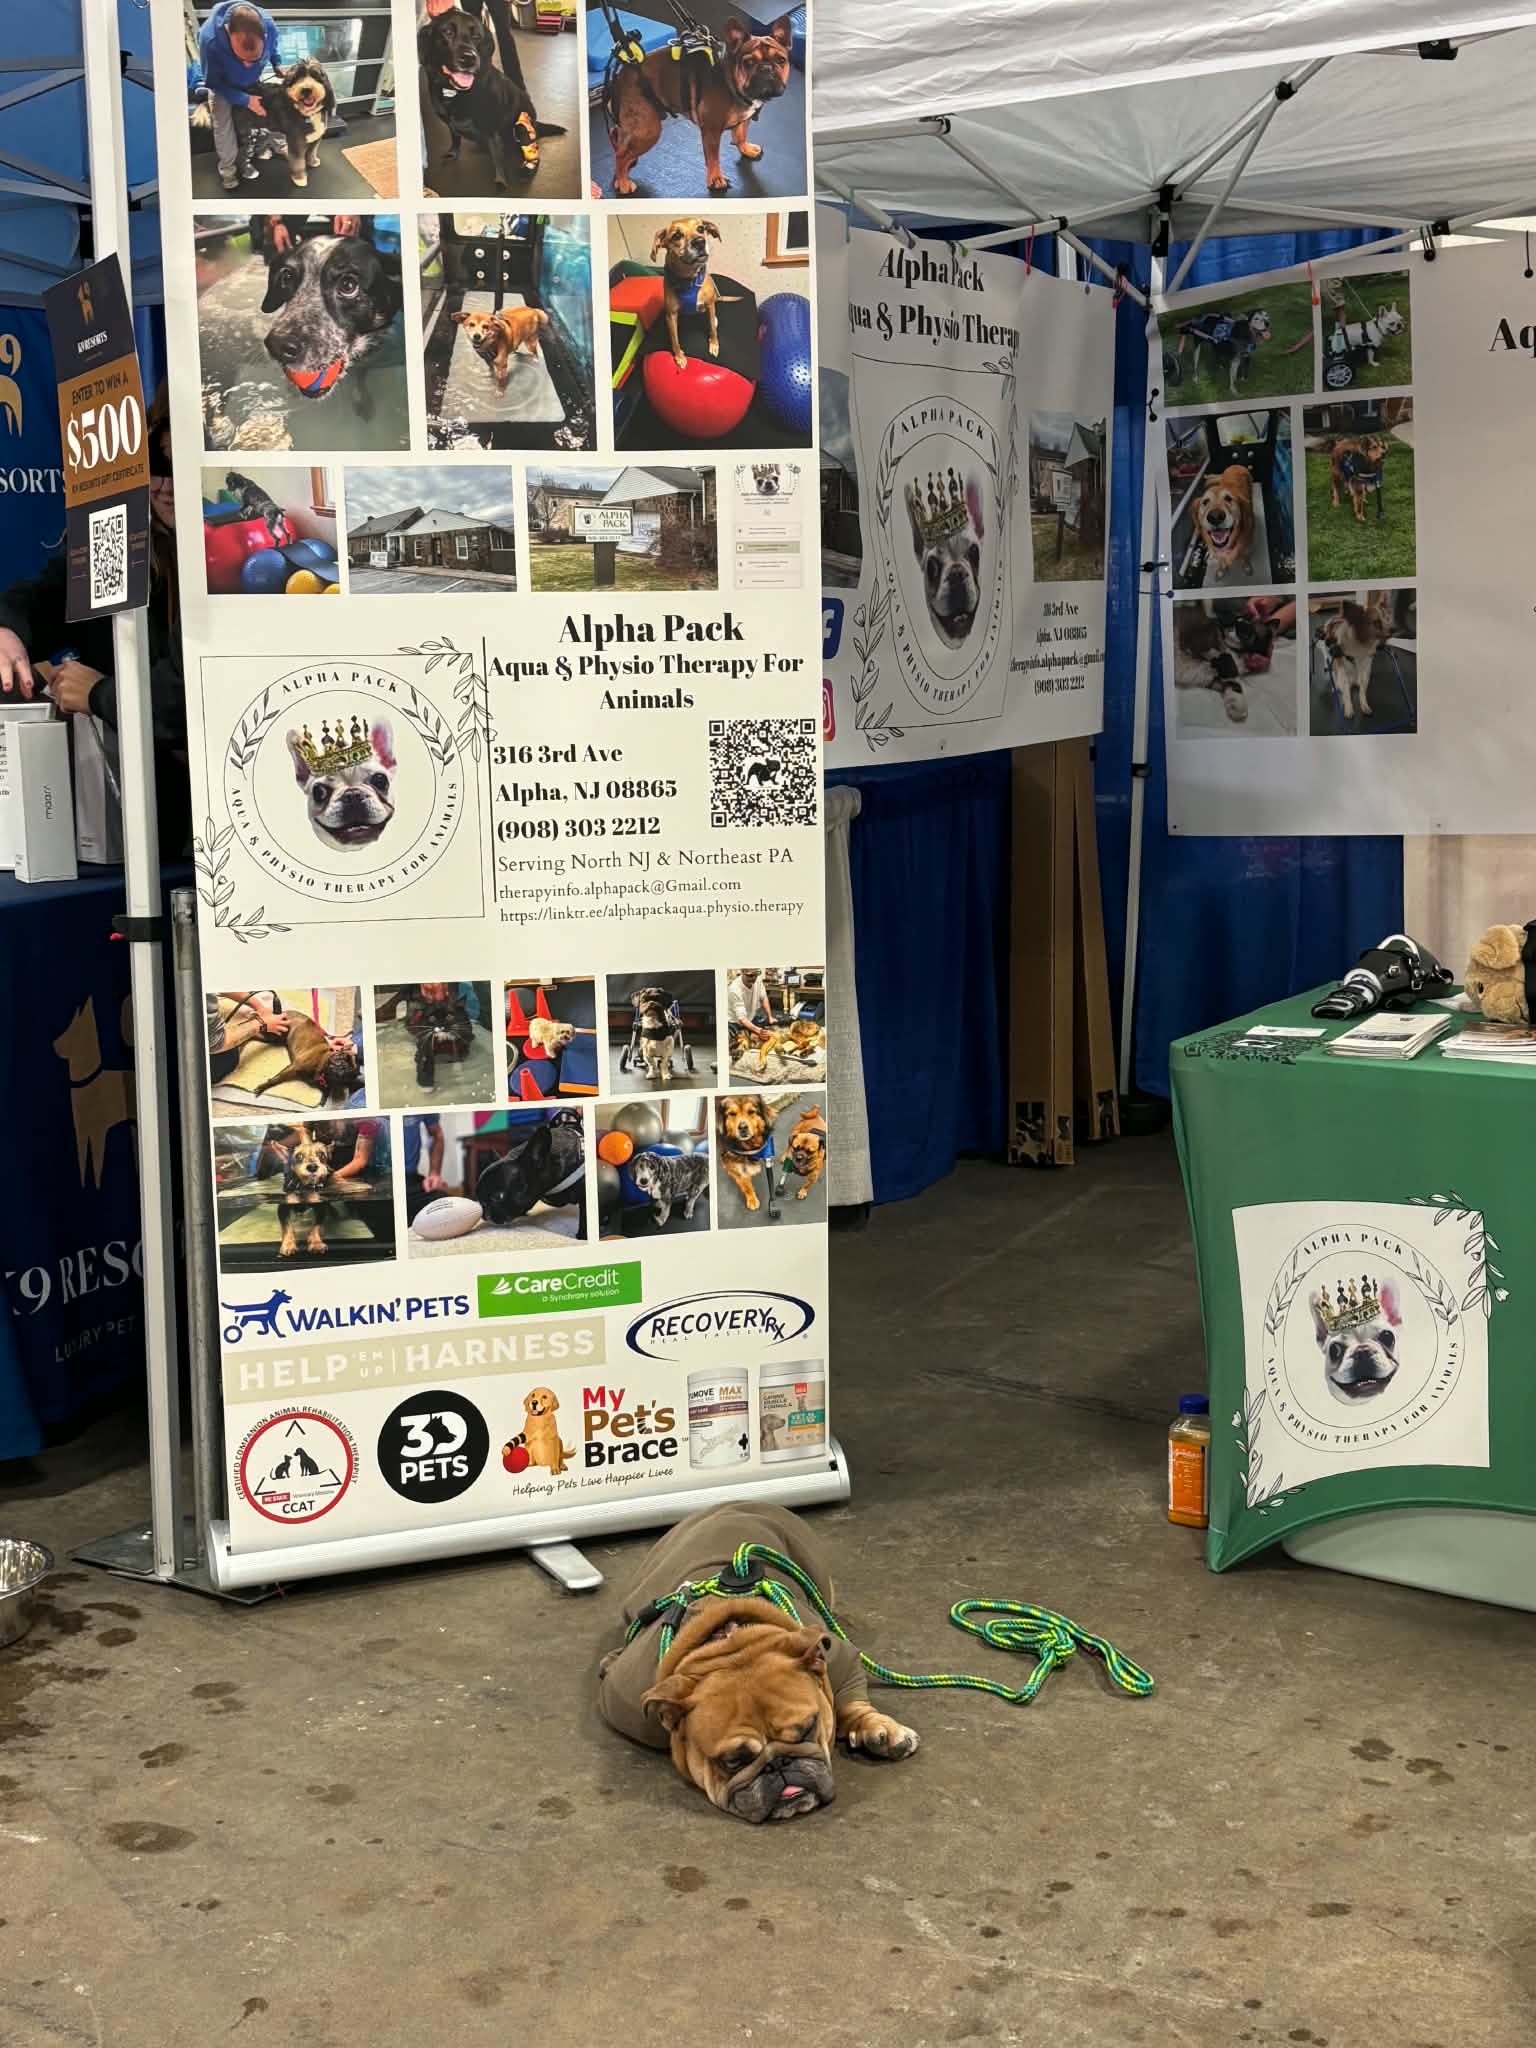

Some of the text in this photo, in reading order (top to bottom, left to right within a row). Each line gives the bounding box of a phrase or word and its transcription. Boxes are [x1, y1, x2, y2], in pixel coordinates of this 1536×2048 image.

[879, 248, 985, 292] Alpha Pack
[876, 302, 893, 341] &
[898, 304, 959, 346] Physio
[72, 384, 92, 405] ENTER
[94, 379, 105, 395] TO
[67, 395, 142, 474] $500
[899, 407, 985, 440] ALPHA PACK
[0, 466, 66, 494] SORT
[600, 511, 629, 520] ALPHA
[603, 519, 626, 529] PACK
[559, 612, 745, 651] Alpha Pack
[488, 653, 804, 682] Aqua & Physio Therapy For
[281, 671, 399, 695] ALPHA PACK
[599, 688, 694, 710] Animals
[493, 744, 623, 764] 316 3rd Ave
[495, 779, 677, 807] Alpha, NJ 08865
[231, 787, 250, 830] AQUA
[261, 848, 315, 888] PHYSIO
[323, 874, 397, 893] THERAPY
[402, 852, 429, 875] FOR
[429, 782, 458, 849] ANIMALS
[497, 816, 661, 842] (908) 303 2212
[498, 847, 794, 875] Serving North NJ & Northeast PA
[499, 878, 743, 902] therapyinfo.alphapack@Gmail.com
[1303, 1232, 1403, 1256] ALPHA PACK
[5, 1266, 51, 1316] 9
[513, 1268, 620, 1296] CareCredit
[590, 1288, 620, 1299] solution
[286, 1295, 471, 1333] WALKIN' PETS
[650, 1336, 689, 1345] HEAL
[238, 1353, 349, 1393] HELP
[404, 1327, 596, 1374] HARNESS
[360, 1365, 384, 1378] UP
[583, 1386, 626, 1411] My
[719, 1385, 743, 1396] MAX
[235, 1416, 268, 1460] COMPANION
[269, 1406, 300, 1419] ANIMAL
[302, 1406, 354, 1442] REHABILITATION
[399, 1410, 468, 1459] 3D
[584, 1400, 675, 1441] Pet's
[1287, 1414, 1329, 1443] PHYSIO
[1334, 1424, 1399, 1445] THERAPY
[1403, 1407, 1430, 1426] FOR
[584, 1437, 677, 1468] Brace
[400, 1454, 469, 1485] PETS
[512, 1467, 674, 1497] Helping Pets Live Happier Lives
[282, 1500, 316, 1514] CCAT
